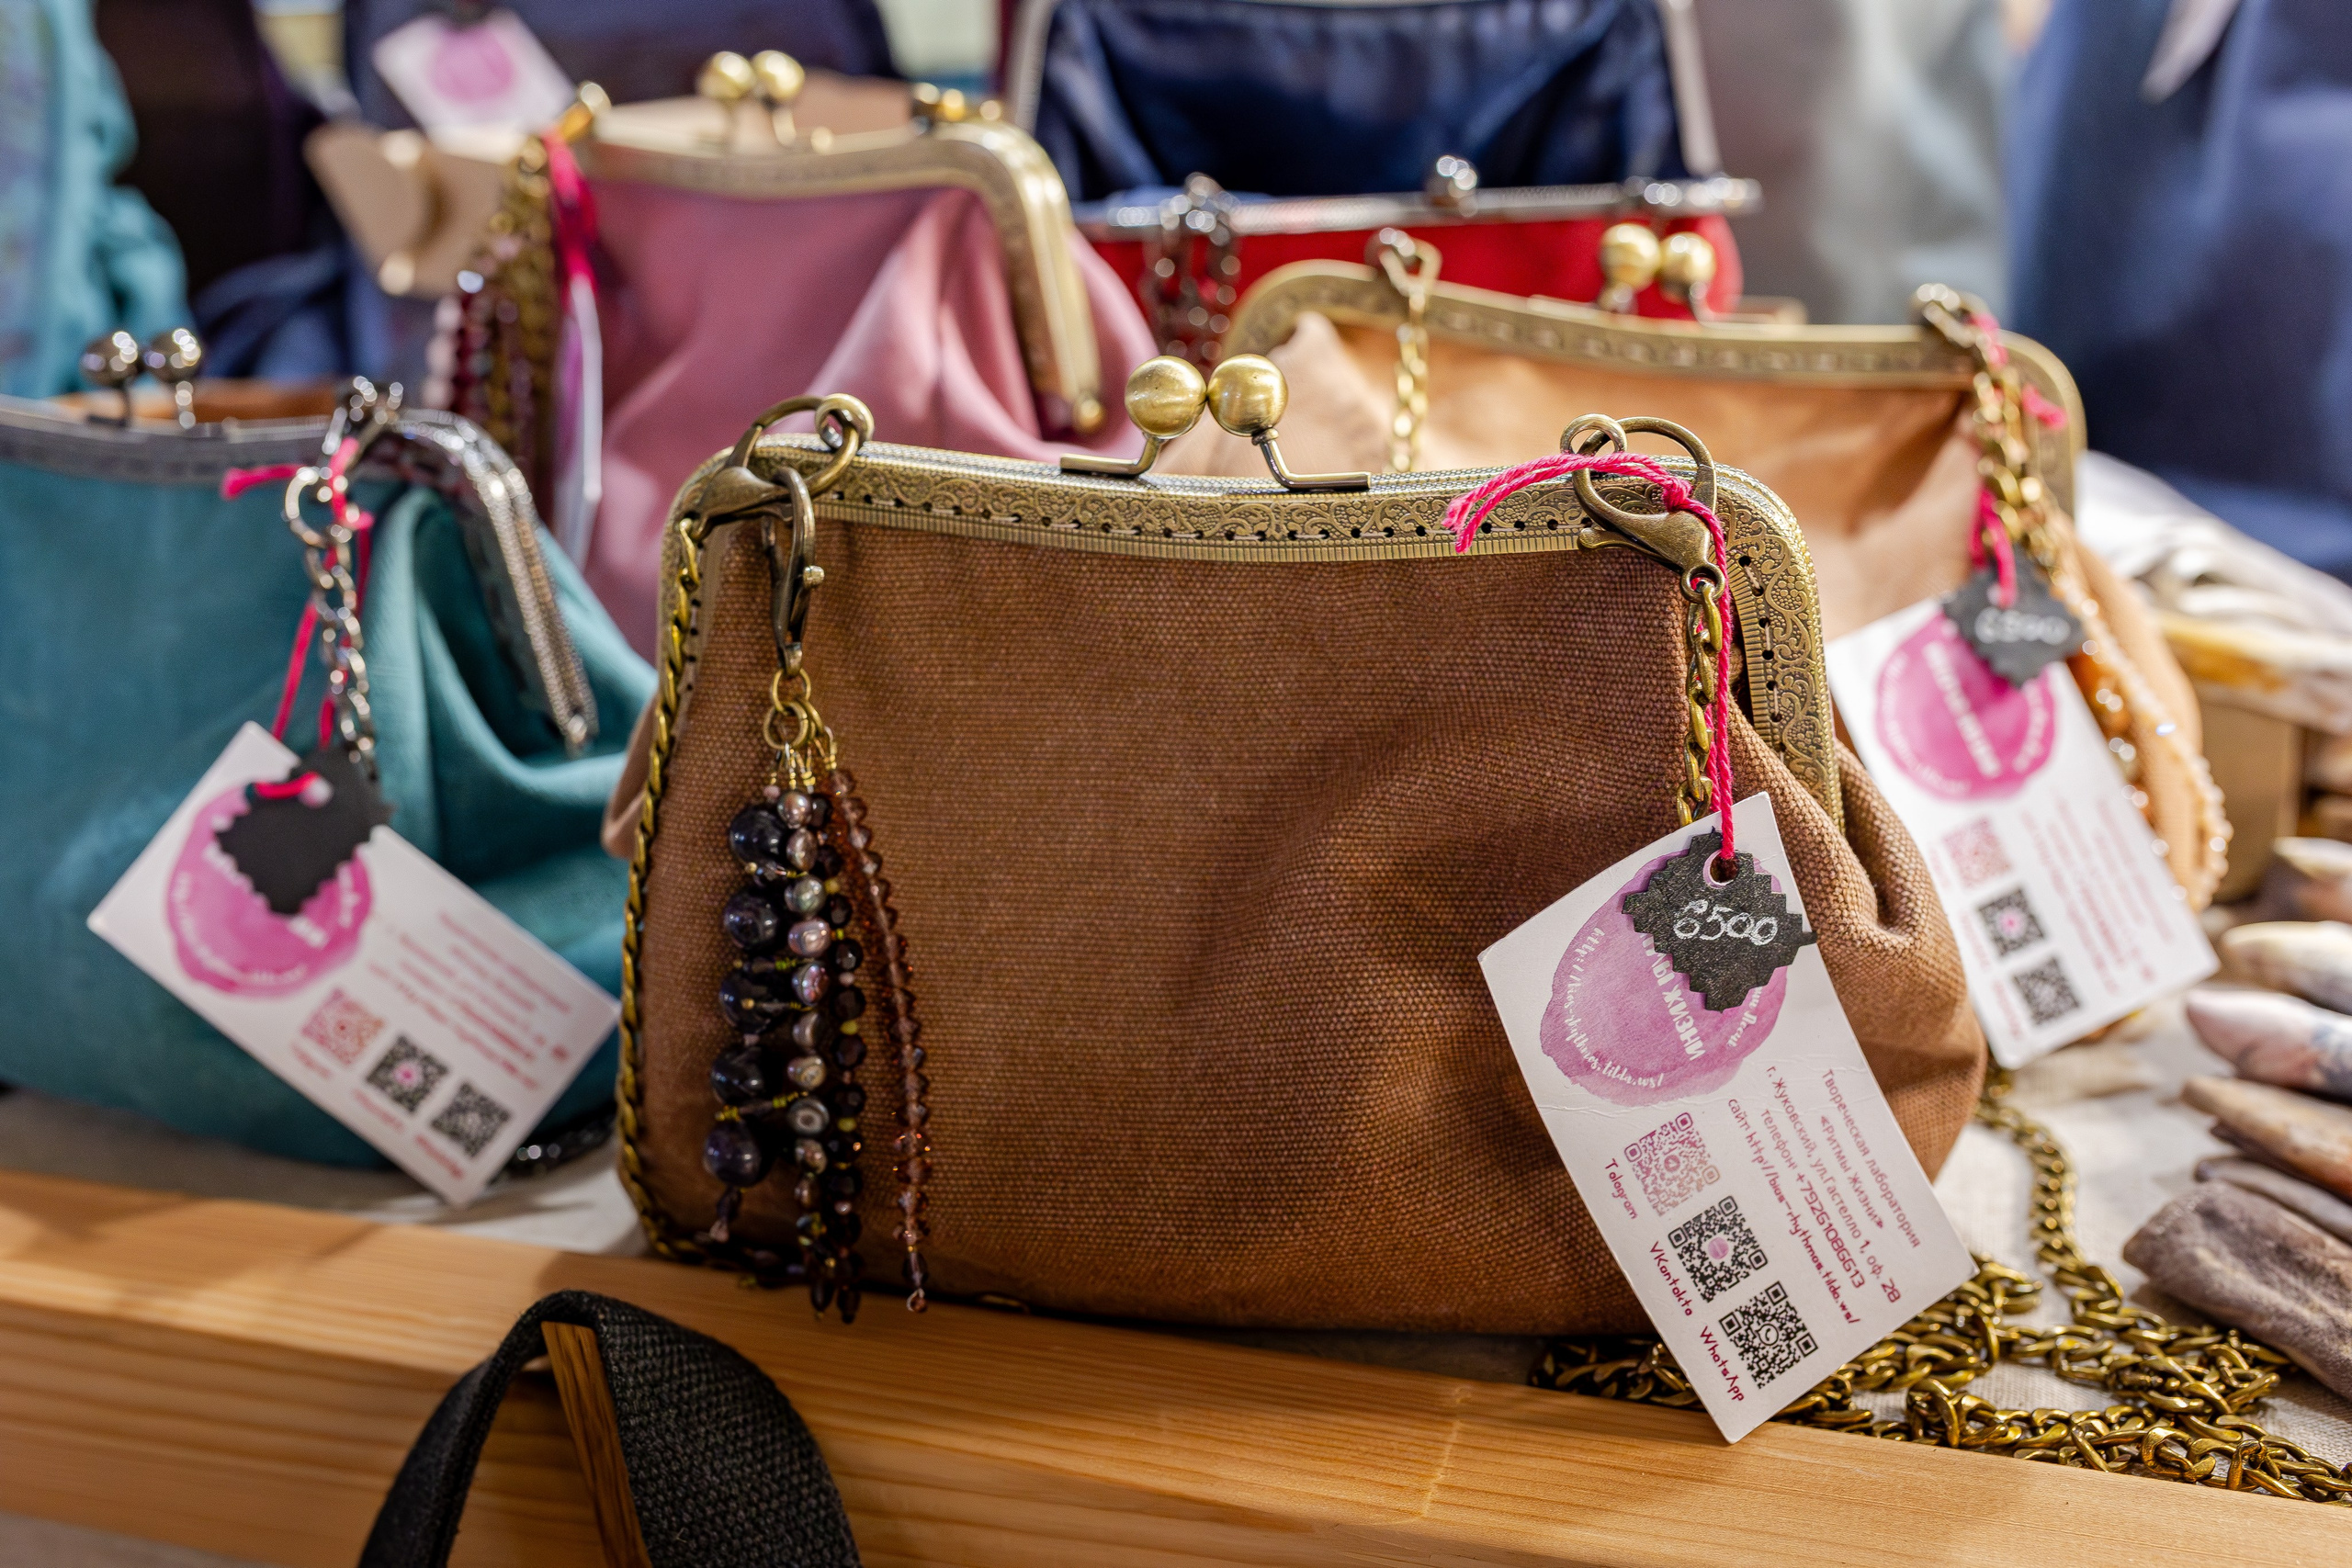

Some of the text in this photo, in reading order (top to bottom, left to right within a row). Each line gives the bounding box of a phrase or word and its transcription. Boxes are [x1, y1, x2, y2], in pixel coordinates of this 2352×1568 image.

[1662, 987, 1707, 1062] ЖИЗНИ
[1772, 1077, 1817, 1158] Жуковский,
[1866, 1255, 1883, 1280] оф.
[1882, 1278, 1901, 1303] 28
[1795, 1172, 1866, 1289] +79261086613
[1866, 1153, 1920, 1248] лаборатория
[1699, 1325, 1745, 1403] WhatsApp
